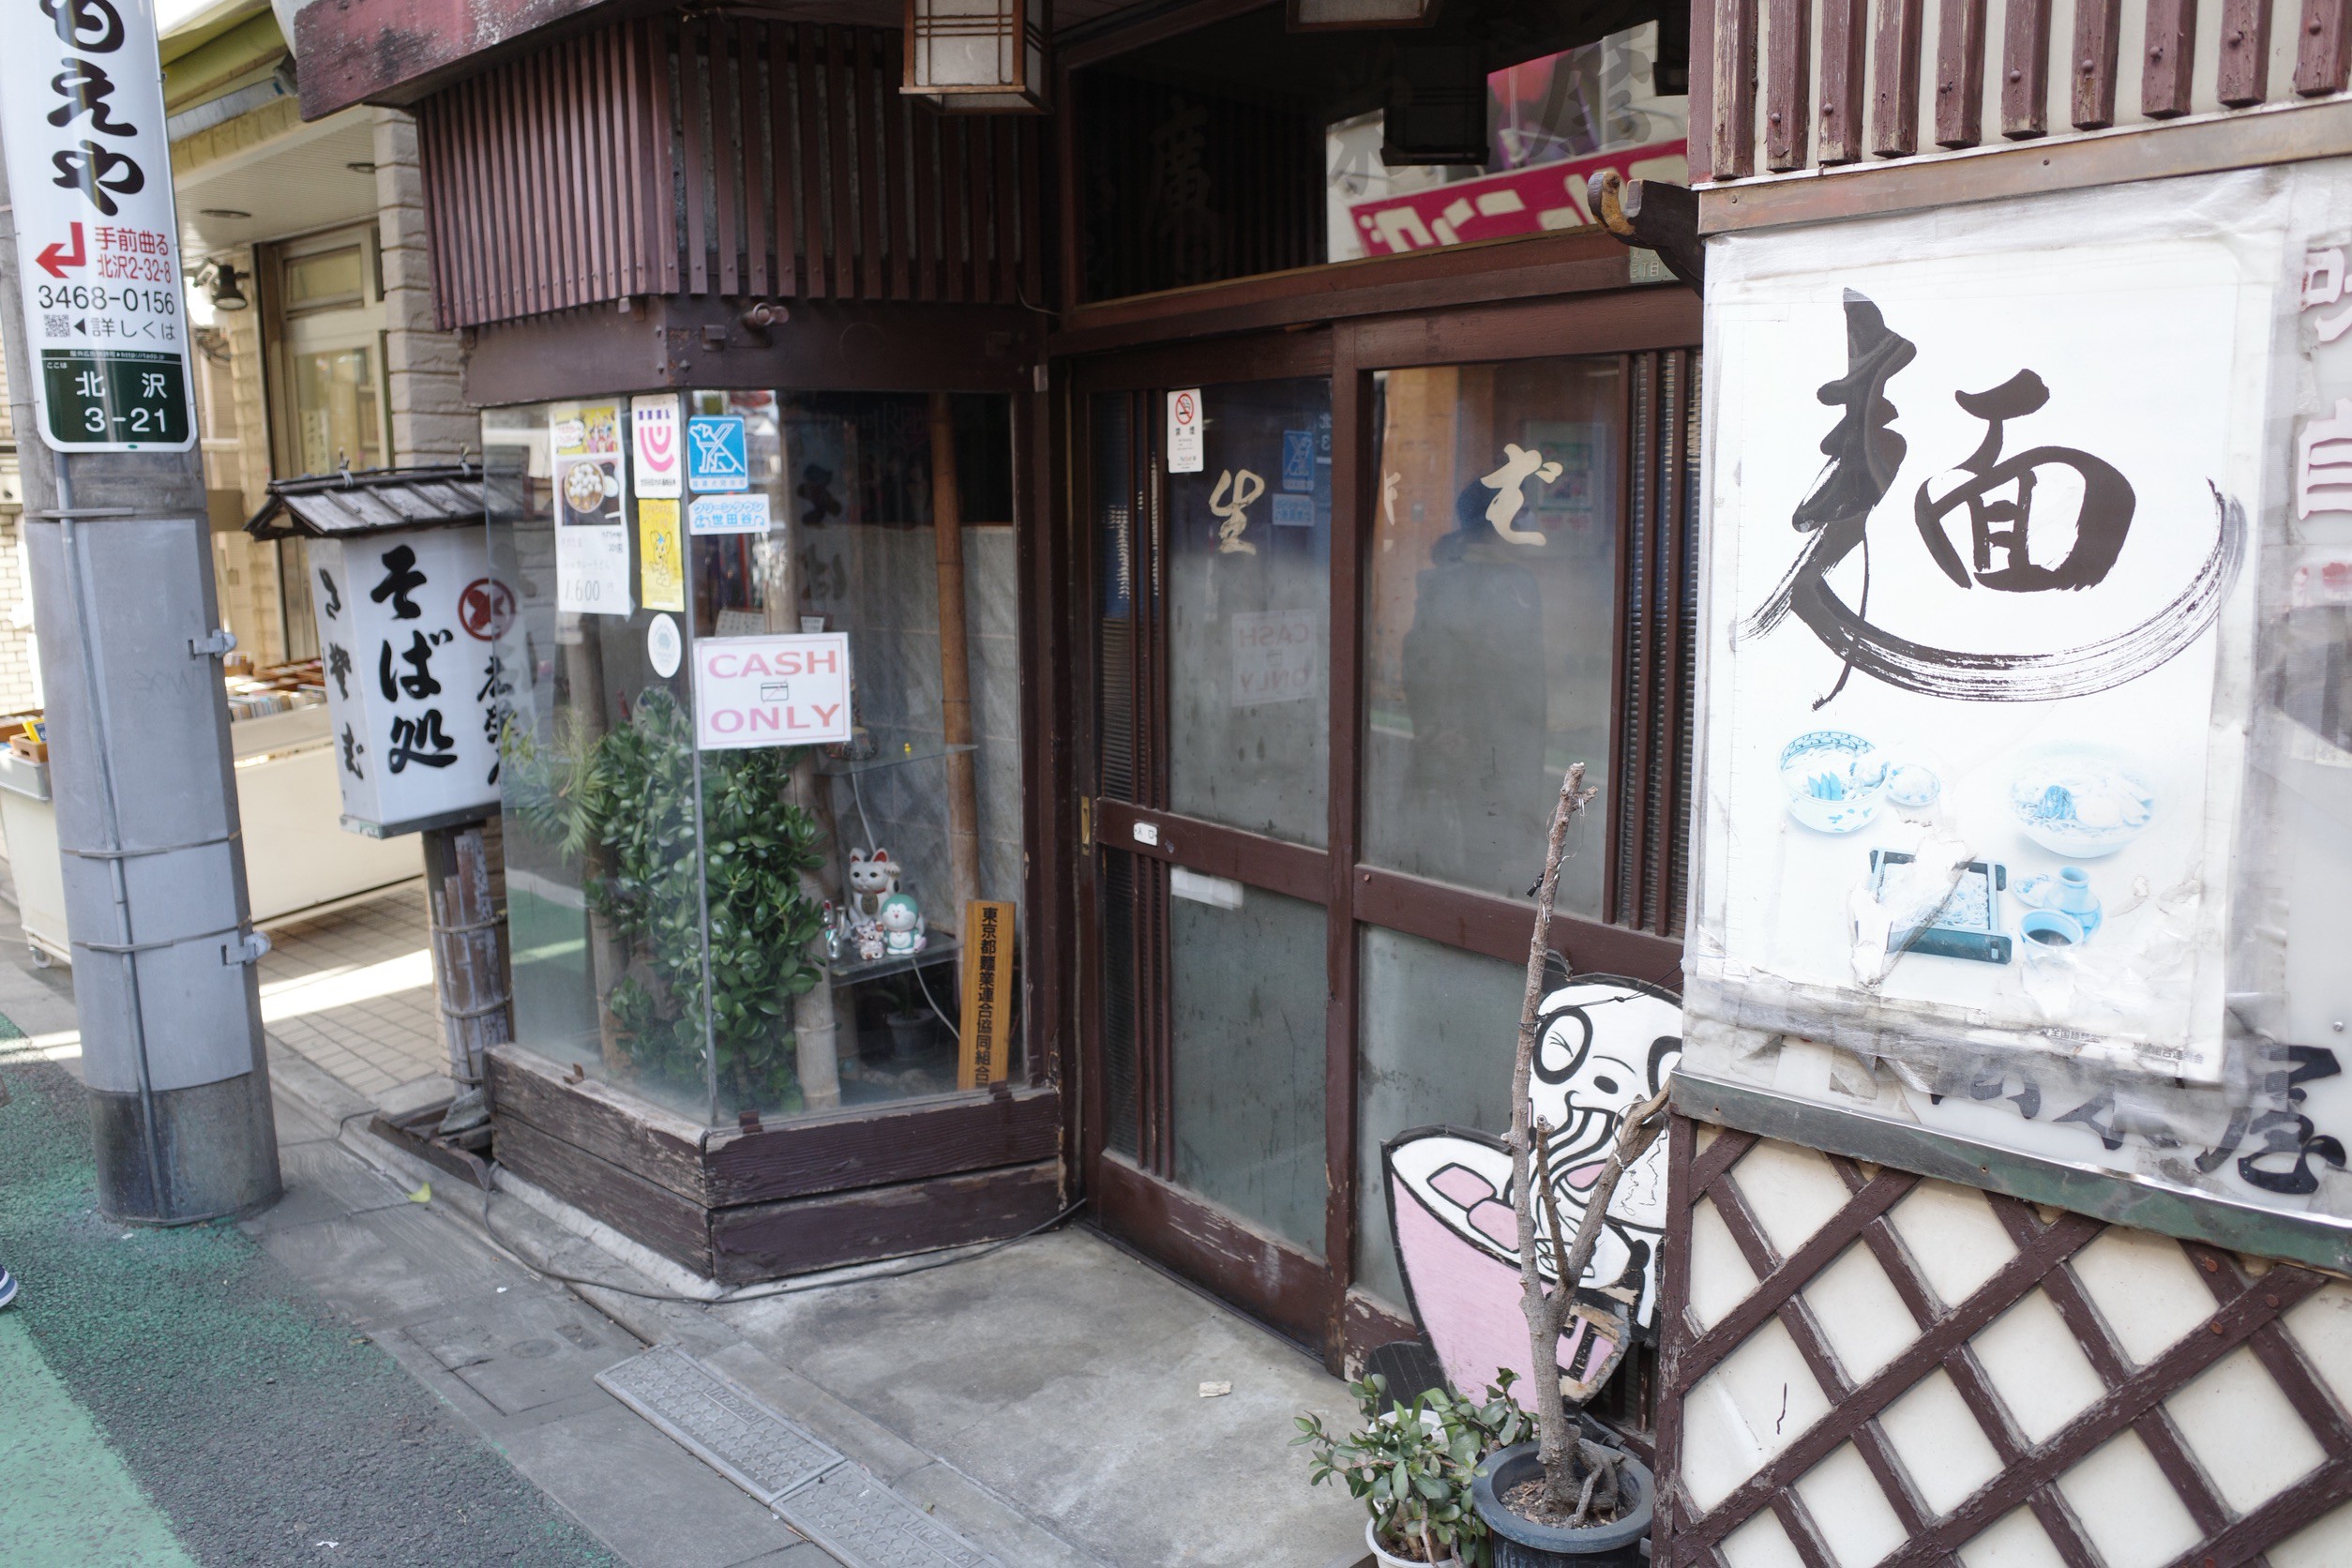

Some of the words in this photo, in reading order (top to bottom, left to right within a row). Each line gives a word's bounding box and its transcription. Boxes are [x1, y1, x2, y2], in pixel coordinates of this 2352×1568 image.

[95, 226, 169, 256] 手前曲る
[97, 253, 172, 283] 北沢2-32-8
[1631, 261, 1659, 279] 三丁目
[38, 285, 174, 315] 3468-0156
[90, 317, 175, 340] 詳しくは
[75, 370, 168, 398] 北沢
[84, 407, 166, 432] 3-21
[694, 502, 764, 514] グリーンタウン
[1737, 287, 2247, 712] 麺
[713, 513, 752, 525] 世田谷
[369, 544, 458, 774] そば処
[707, 649, 837, 679] CASH
[710, 702, 841, 734] ONLY
